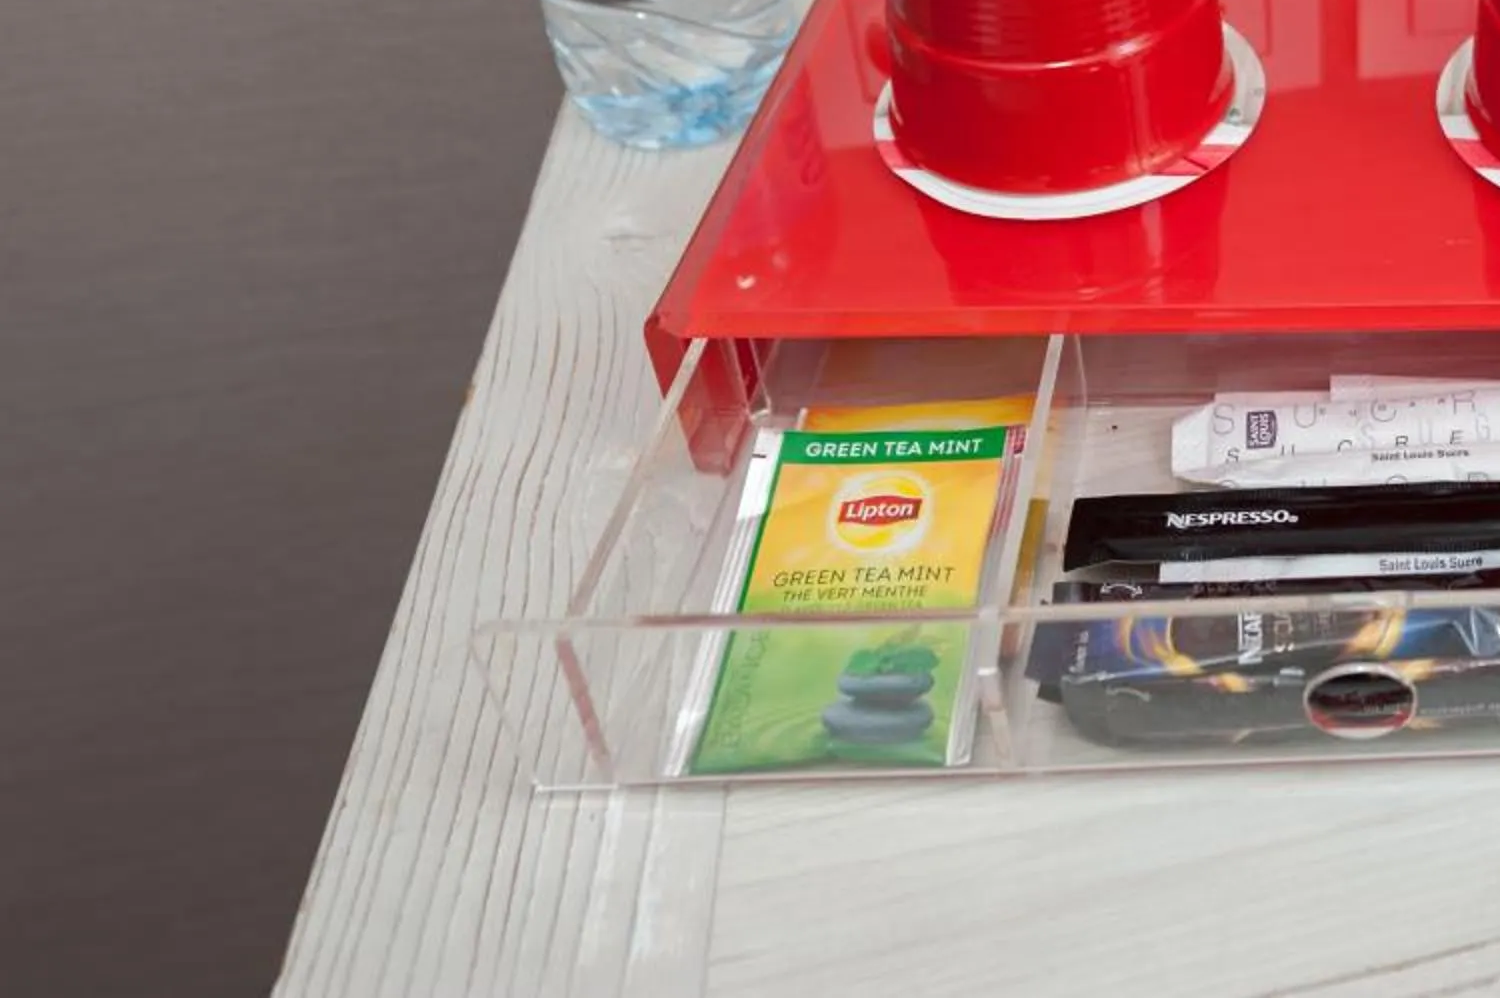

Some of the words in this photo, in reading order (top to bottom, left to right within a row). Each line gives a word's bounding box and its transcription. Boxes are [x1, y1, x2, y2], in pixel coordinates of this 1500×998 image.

[805, 441, 878, 458] GREEN
[884, 440, 923, 456] TEA
[928, 438, 984, 455] MINT
[846, 502, 914, 520] Lipton
[1379, 558, 1412, 573] Saint
[1414, 556, 1447, 570] Louis
[1450, 553, 1484, 569] Sucre
[773, 569, 847, 588] GREEN
[855, 566, 892, 583] TEA
[898, 564, 957, 583] MINT
[817, 587, 857, 601] VERT
[861, 585, 928, 599] MENTHE
